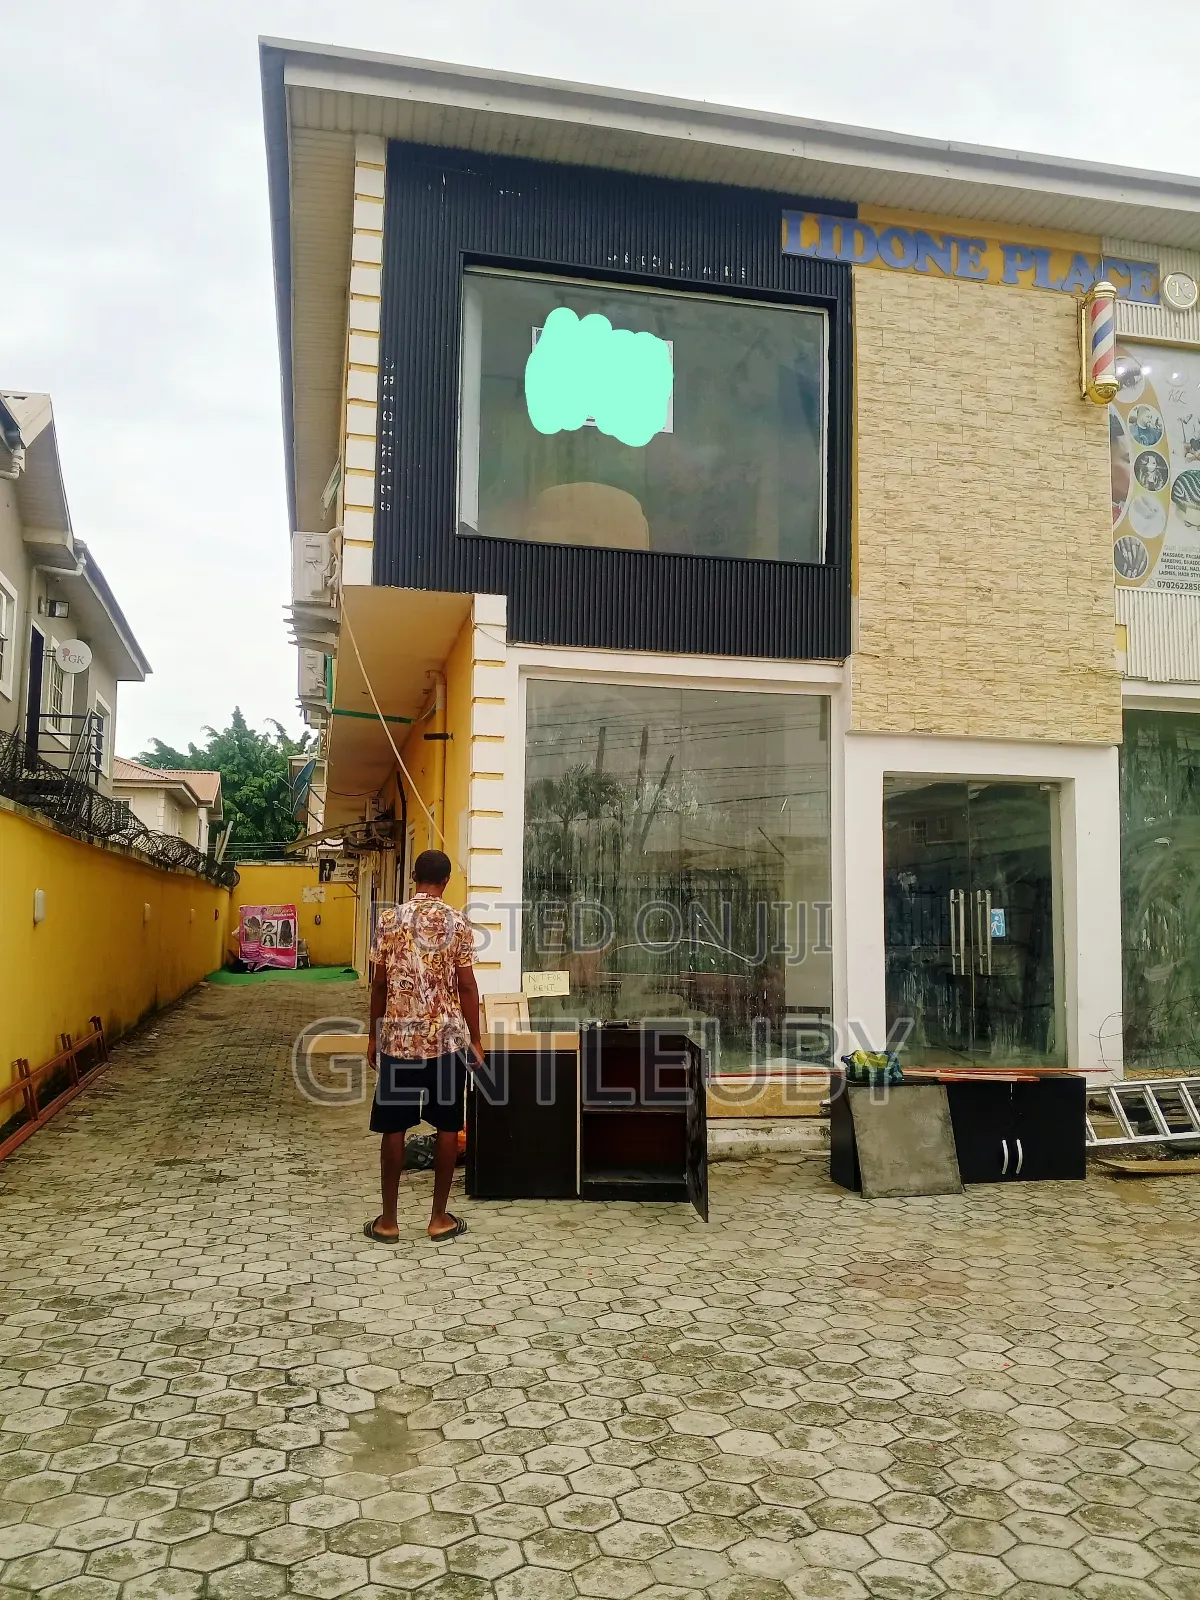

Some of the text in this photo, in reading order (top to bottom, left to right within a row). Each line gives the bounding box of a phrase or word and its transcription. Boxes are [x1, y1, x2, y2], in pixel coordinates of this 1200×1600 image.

[781, 209, 988, 280] LIDONE
[999, 243, 1160, 305] PLACE
[547, 973, 562, 982] FOR
[533, 983, 555, 992] RENT
